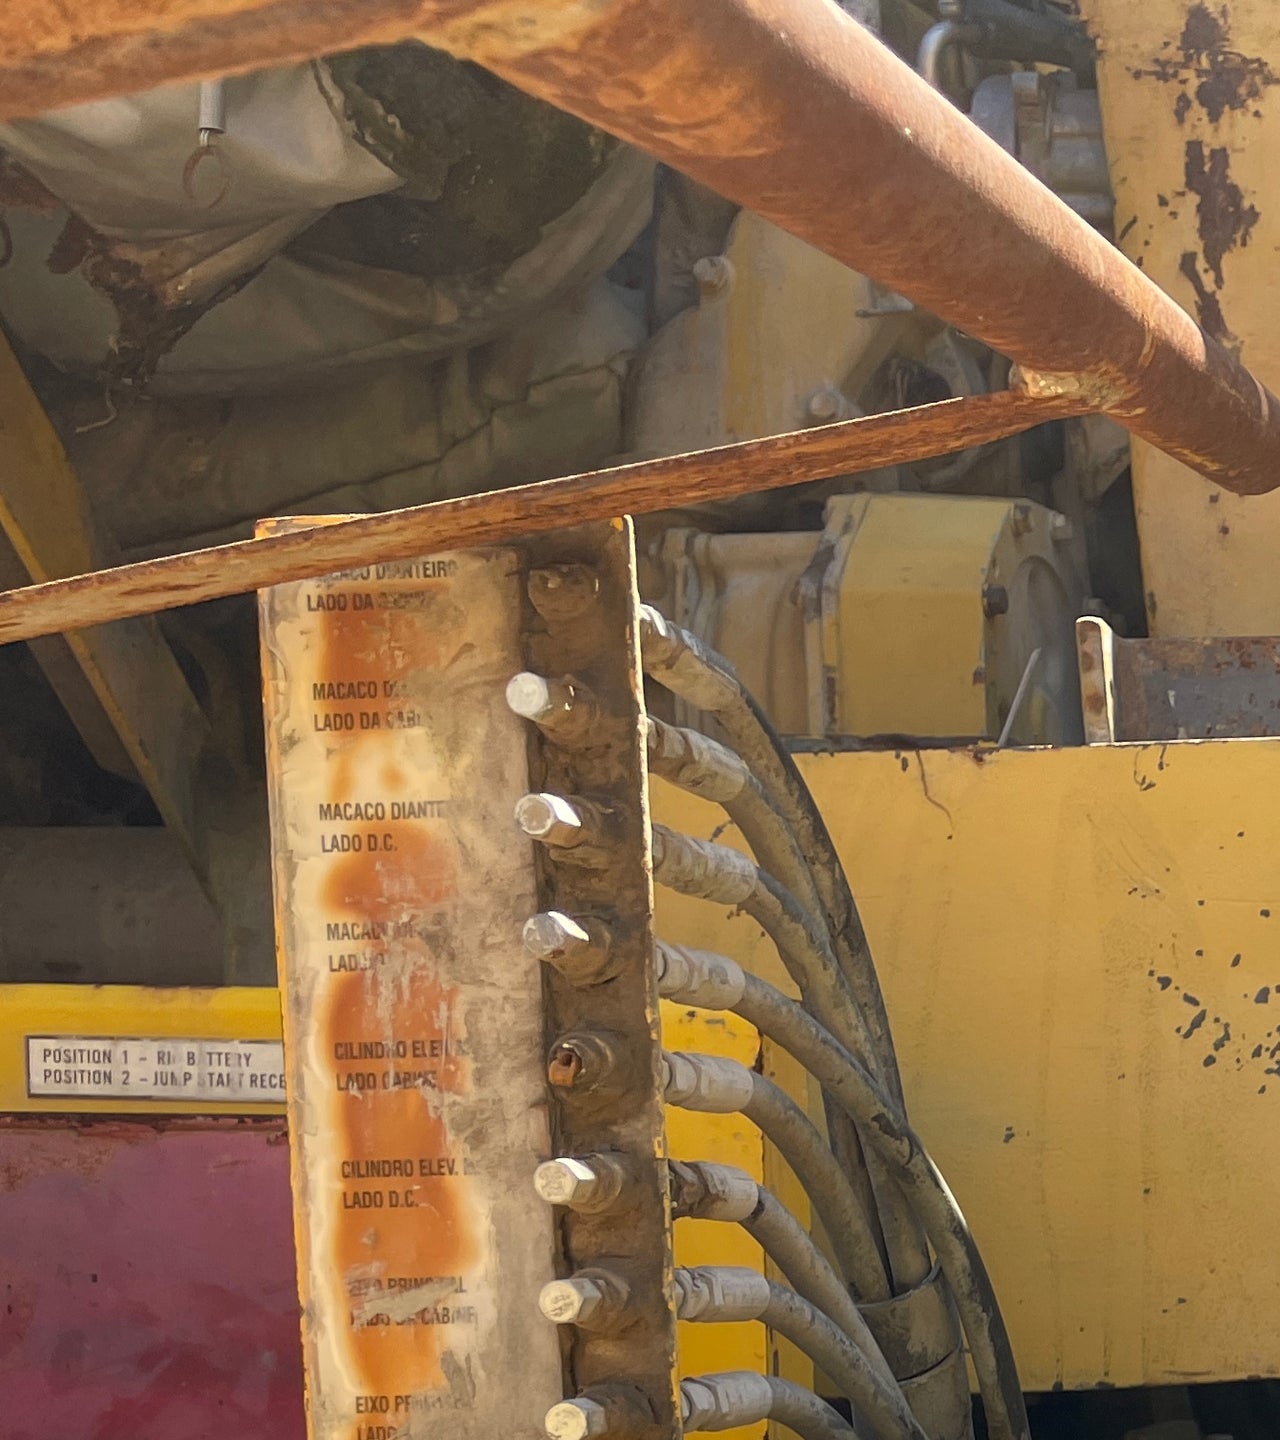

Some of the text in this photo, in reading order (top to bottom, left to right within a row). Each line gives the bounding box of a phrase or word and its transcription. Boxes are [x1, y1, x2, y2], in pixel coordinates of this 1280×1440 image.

[307, 594, 347, 612] LADO
[352, 593, 374, 611] DA
[312, 681, 378, 700] MACACO
[314, 712, 354, 731] LADO
[360, 711, 380, 730] DA
[319, 802, 385, 821] MACACO
[321, 833, 398, 853] LADO D.C.
[43, 1047, 112, 1064] POSITION
[122, 1050, 129, 1065] 1
[186, 1050, 252, 1068] BTTEY
[43, 1069, 112, 1086] POSITION
[121, 1071, 131, 1086] 2
[336, 1072, 377, 1091] LADO
[341, 1159, 414, 1179] CILINDRO
[419, 1158, 459, 1177] ELEV.
[343, 1190, 419, 1209] LADO D.C.
[355, 1395, 389, 1414] EIXO
